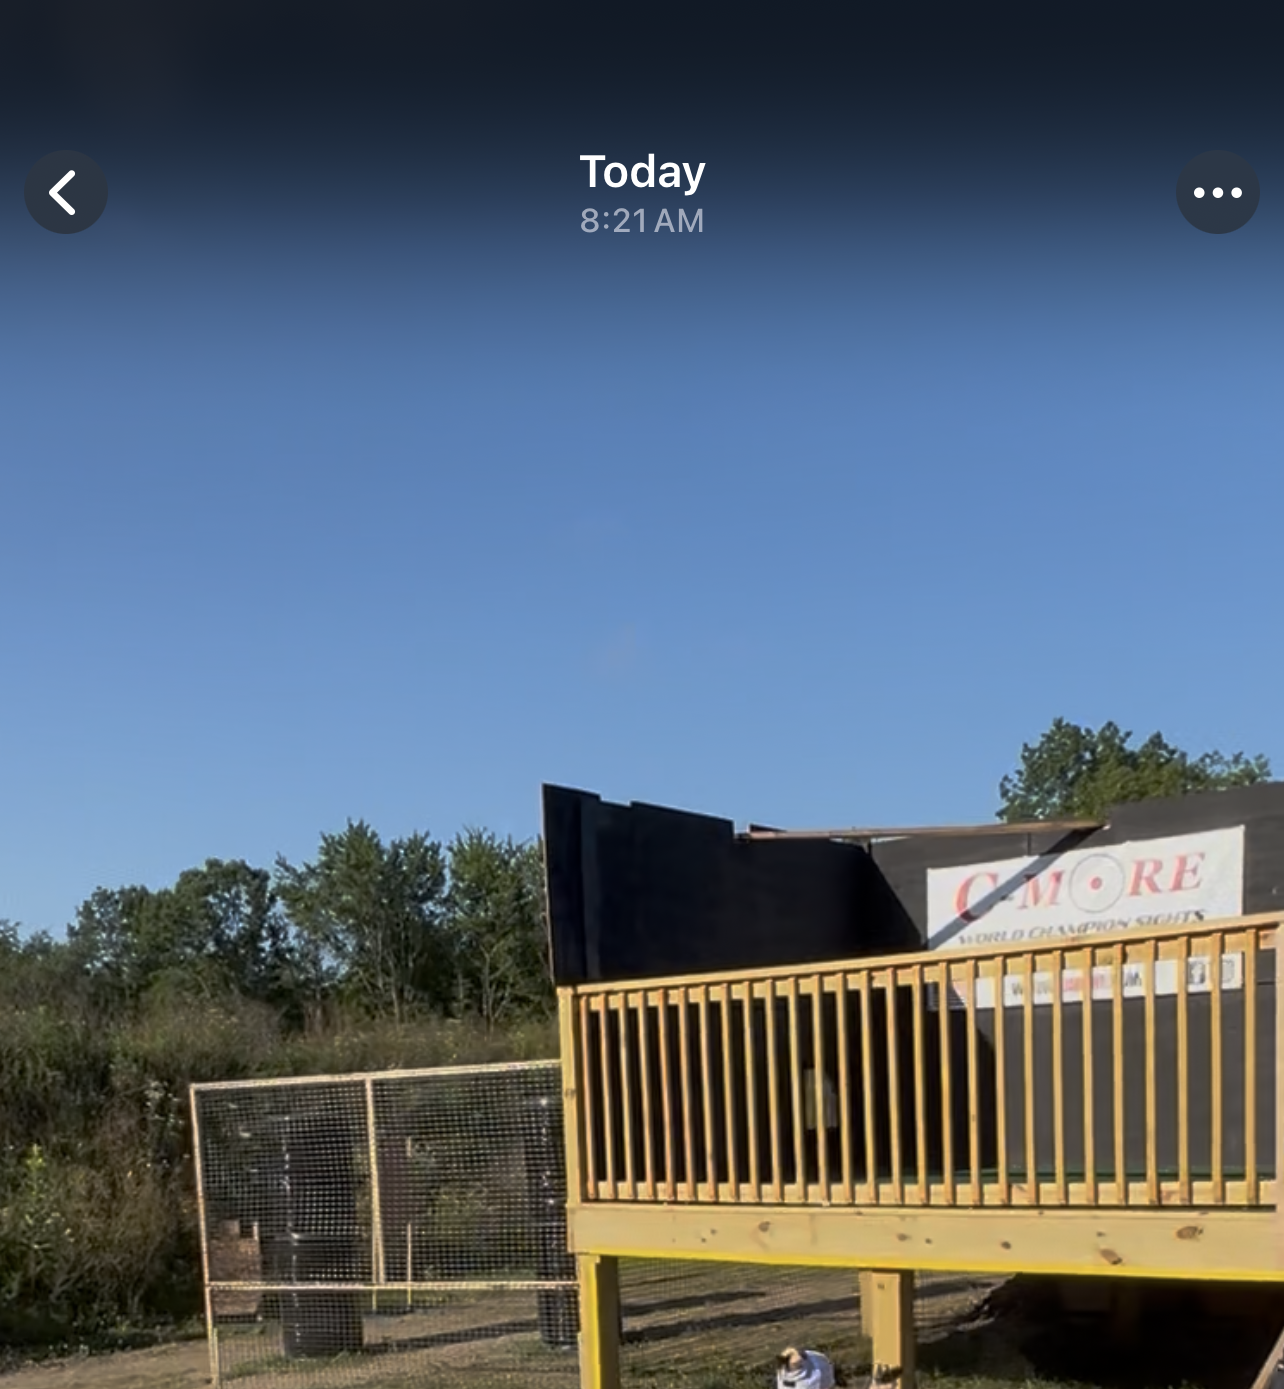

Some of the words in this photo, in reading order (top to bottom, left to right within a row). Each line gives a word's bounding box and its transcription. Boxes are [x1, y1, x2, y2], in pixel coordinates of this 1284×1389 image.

[959, 928, 1024, 946] WORLD
[1028, 916, 1132, 939] CHAMPION
[1136, 908, 1205, 926] SIGHTS
